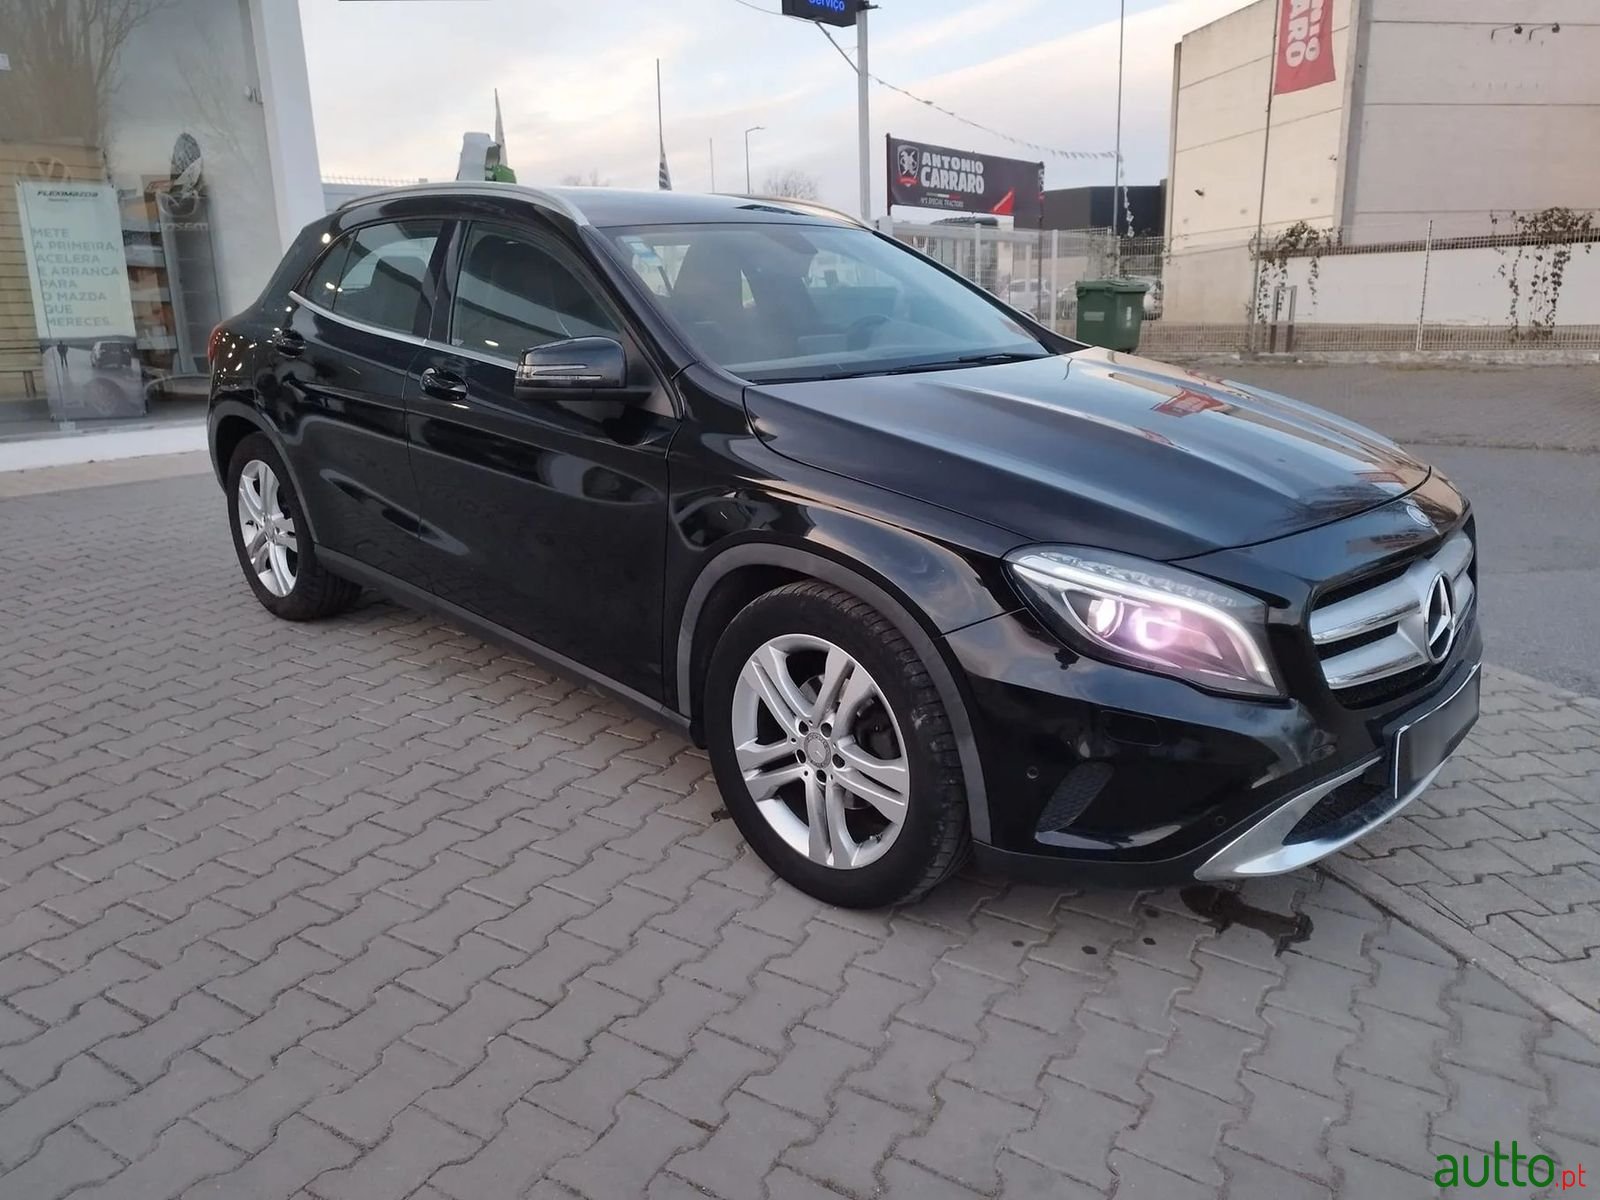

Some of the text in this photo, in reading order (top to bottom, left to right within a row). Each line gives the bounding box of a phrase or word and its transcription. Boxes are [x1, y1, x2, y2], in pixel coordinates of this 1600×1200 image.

[921, 152, 984, 174] ANTONIO
[920, 166, 985, 194] CARRARO
[32, 228, 69, 238] METE
[34, 241, 43, 249] A
[37, 254, 100, 263] ACELERA
[52, 267, 120, 276] ARRANCA
[42, 280, 78, 288] PARA
[44, 292, 107, 301] O MAZDA
[46, 305, 73, 314] QUE
